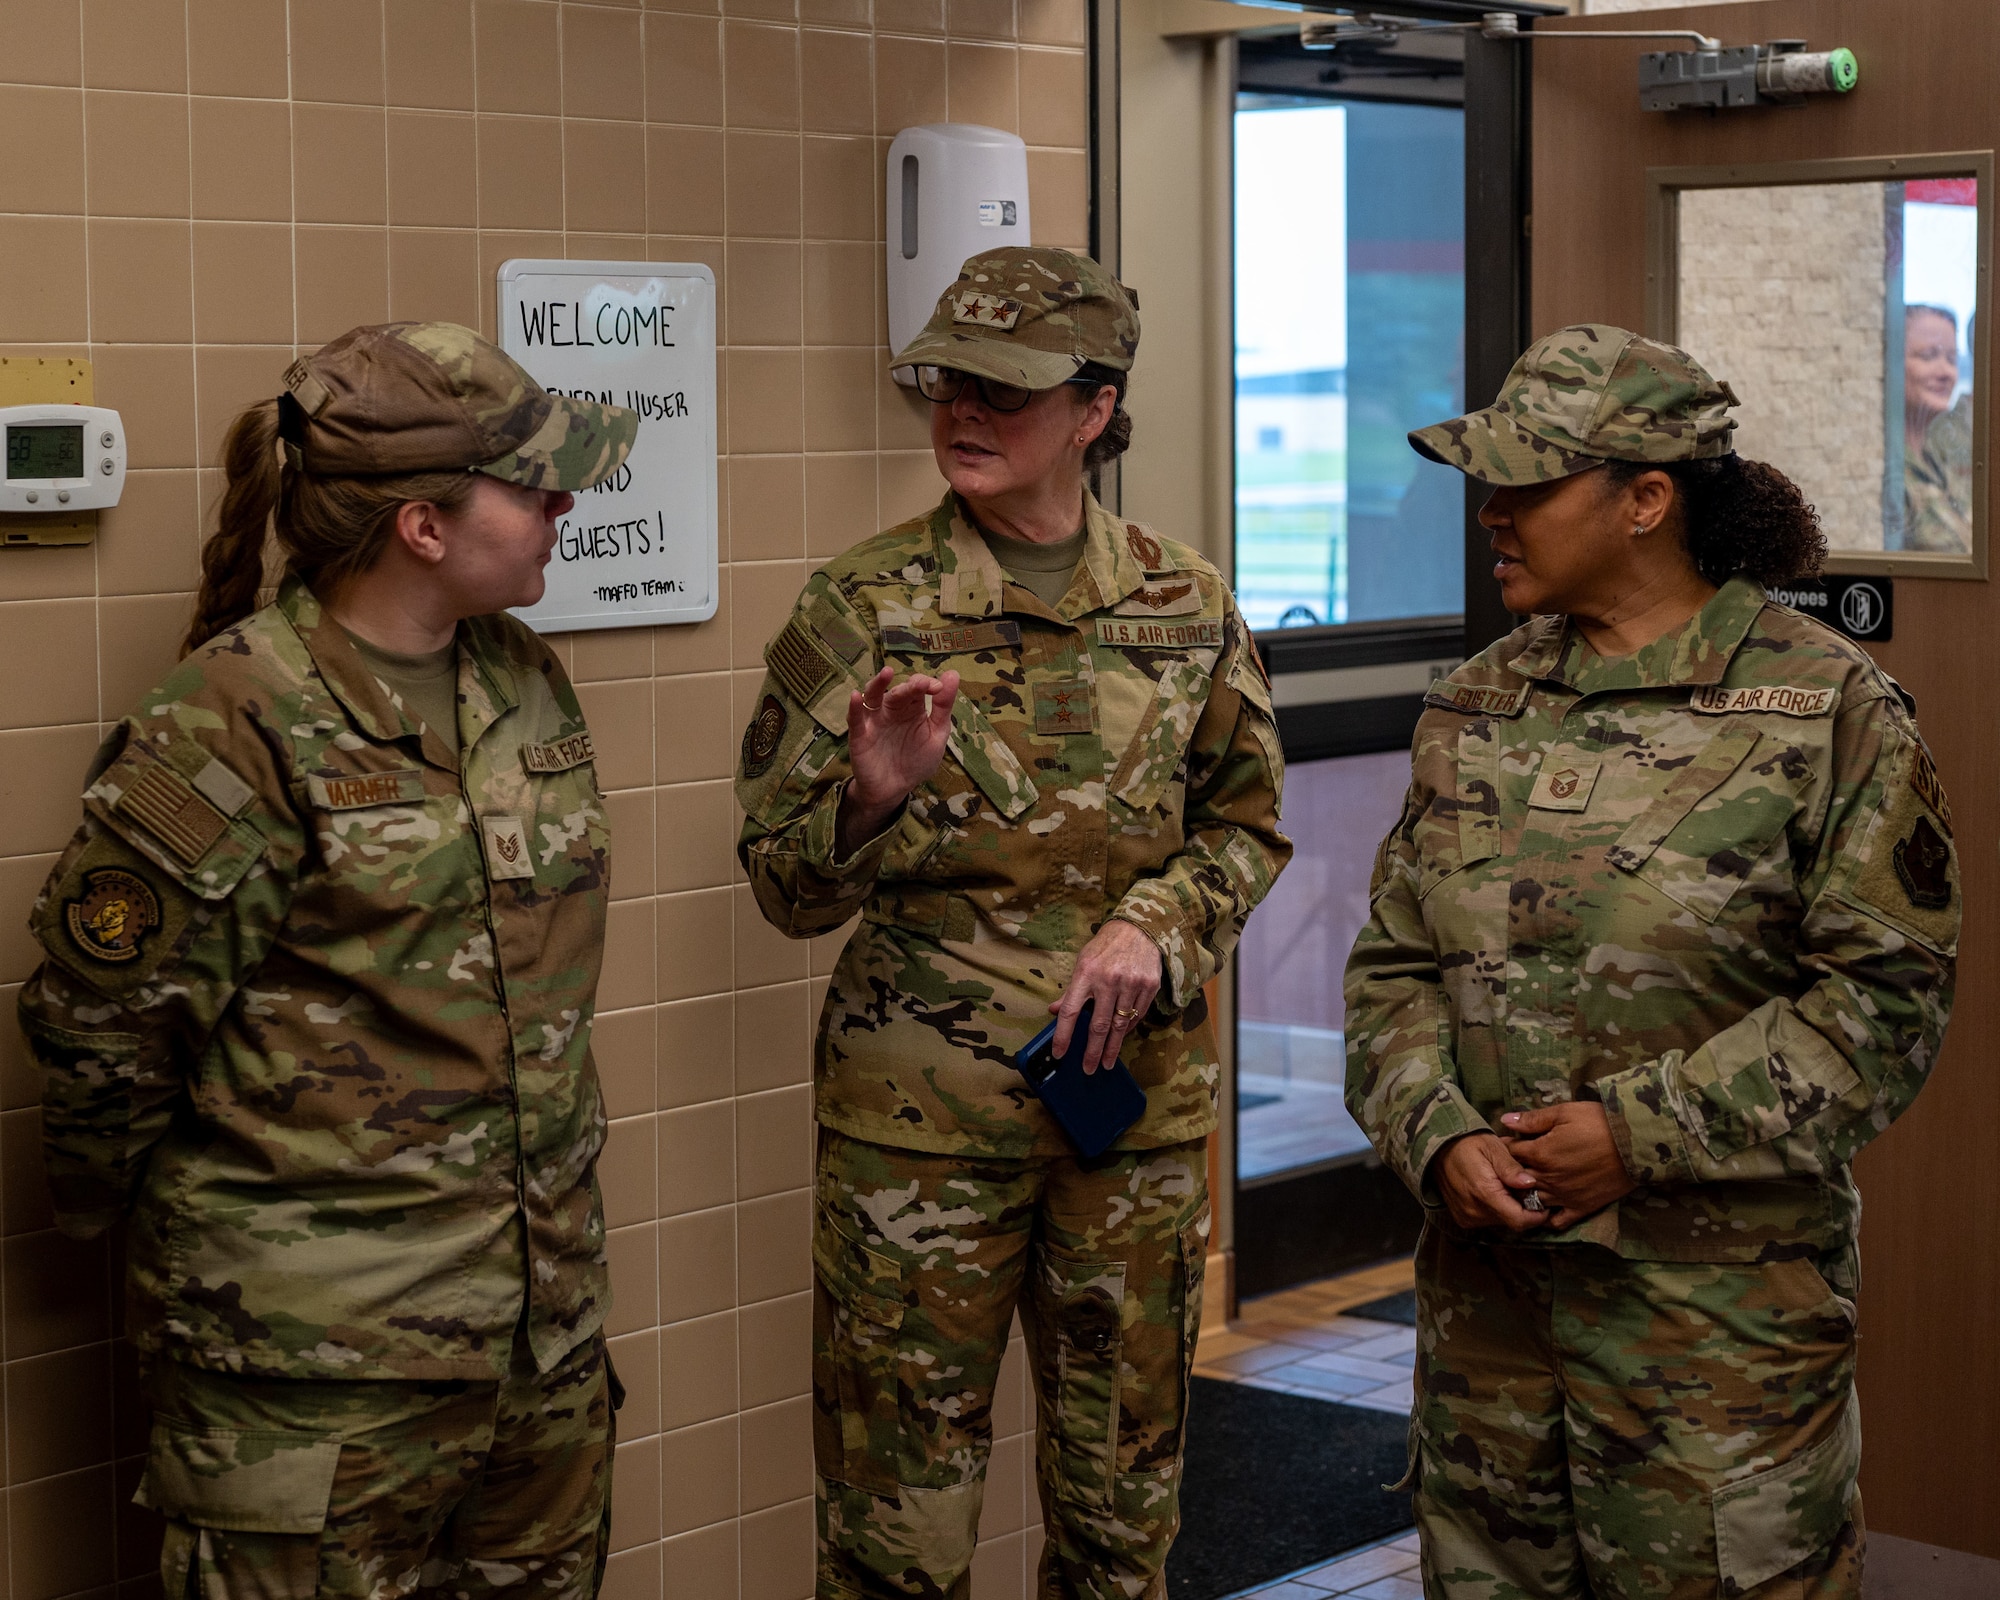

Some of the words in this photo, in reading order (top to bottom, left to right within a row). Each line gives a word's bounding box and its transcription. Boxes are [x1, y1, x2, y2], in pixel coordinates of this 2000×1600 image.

[519, 299, 676, 348] WELCOME
[558, 510, 665, 562] GUESTS!
[640, 579, 676, 597] TEAM
[919, 628, 977, 651] HUSER
[1102, 624, 1135, 643] U.S.
[1137, 625, 1164, 644] AIR
[1166, 623, 1220, 645] FORCE
[1732, 688, 1764, 709] AIR
[1766, 689, 1828, 713] FORCE
